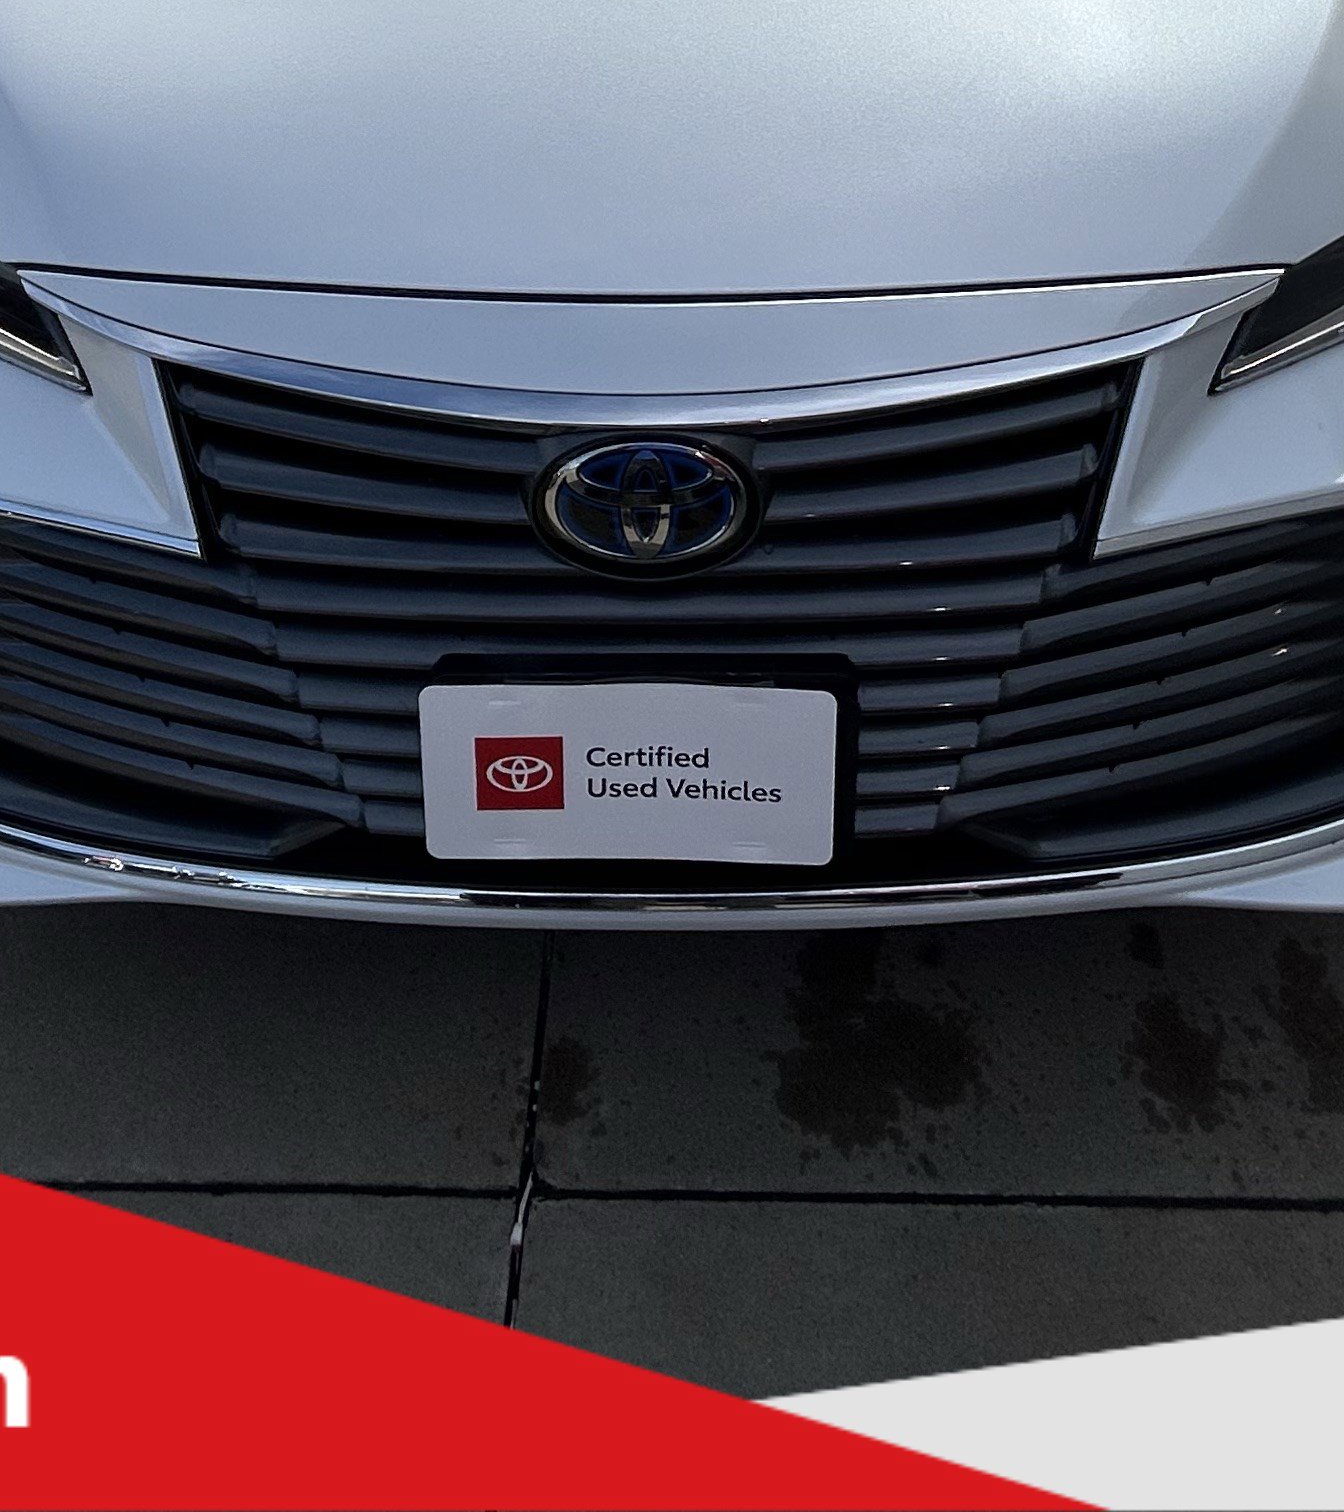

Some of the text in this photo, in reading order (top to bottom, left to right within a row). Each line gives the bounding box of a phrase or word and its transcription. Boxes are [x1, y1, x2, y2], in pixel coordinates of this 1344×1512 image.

[585, 745, 711, 769] Certified
[586, 777, 783, 803] Used Vehicles
